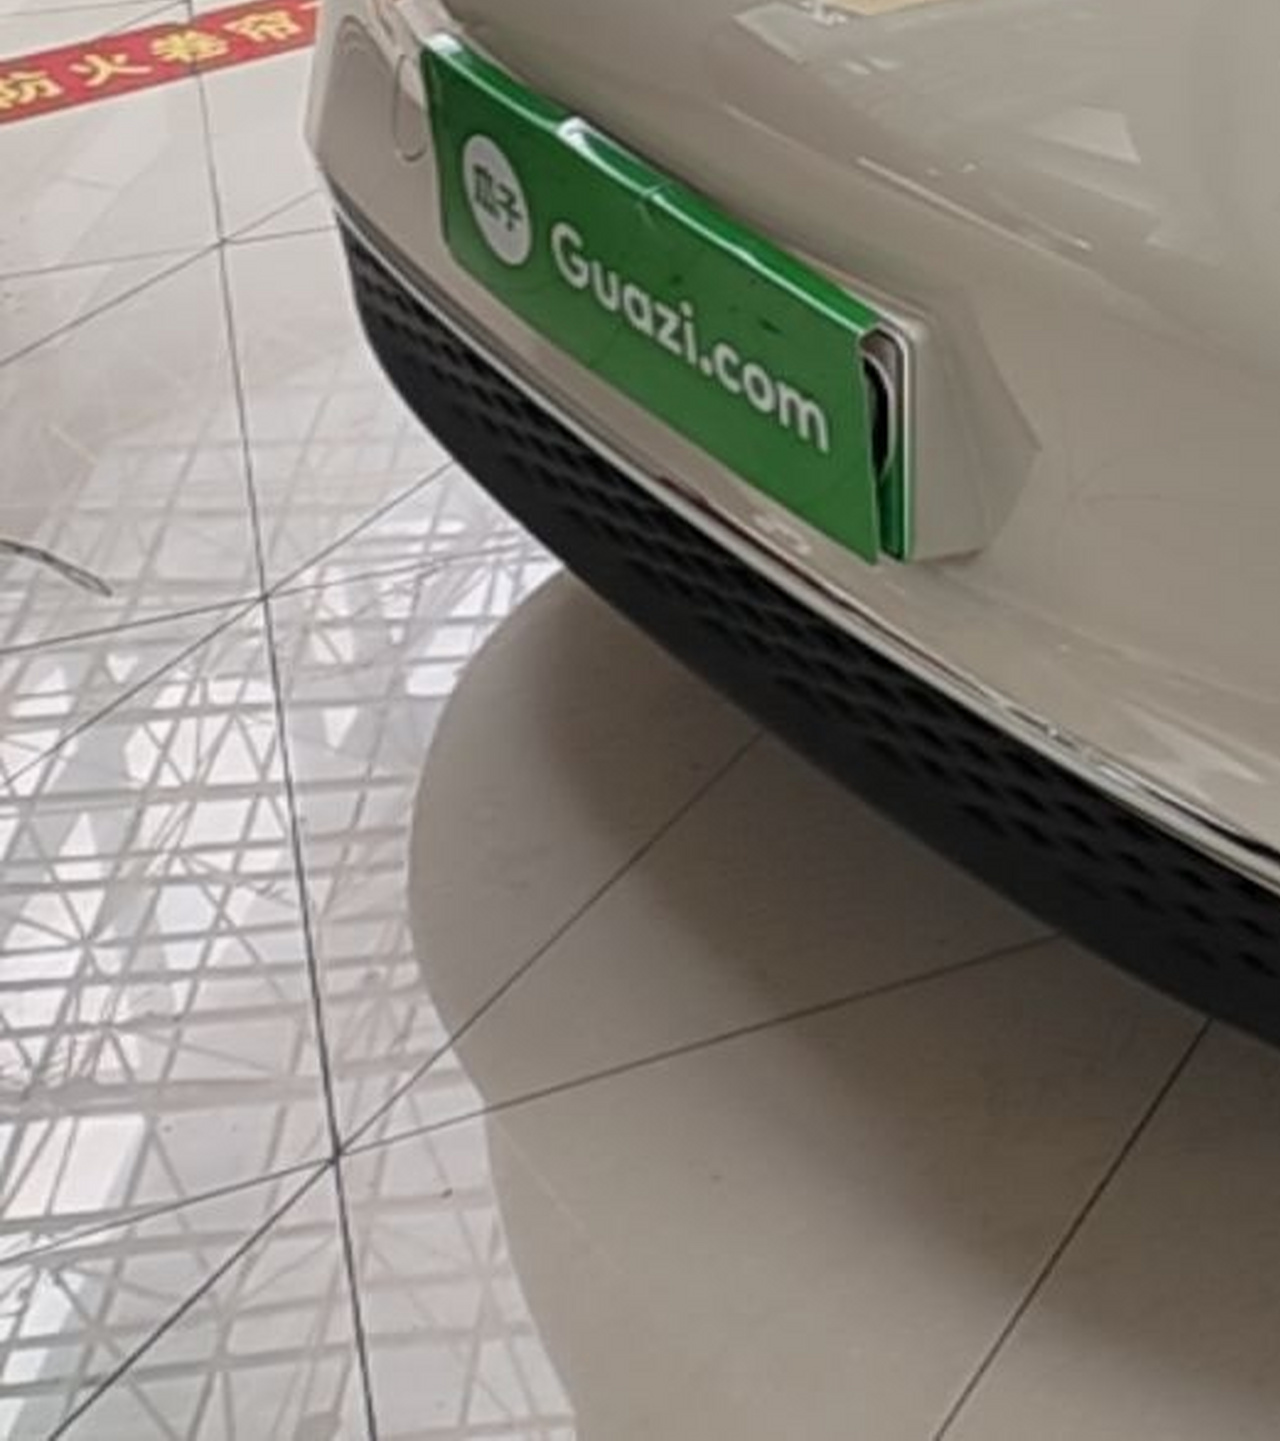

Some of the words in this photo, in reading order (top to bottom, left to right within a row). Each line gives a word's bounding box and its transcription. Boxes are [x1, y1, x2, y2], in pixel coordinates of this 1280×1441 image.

[0, 0, 321, 109] 防火卷帘
[550, 221, 830, 454] Guazi.com
